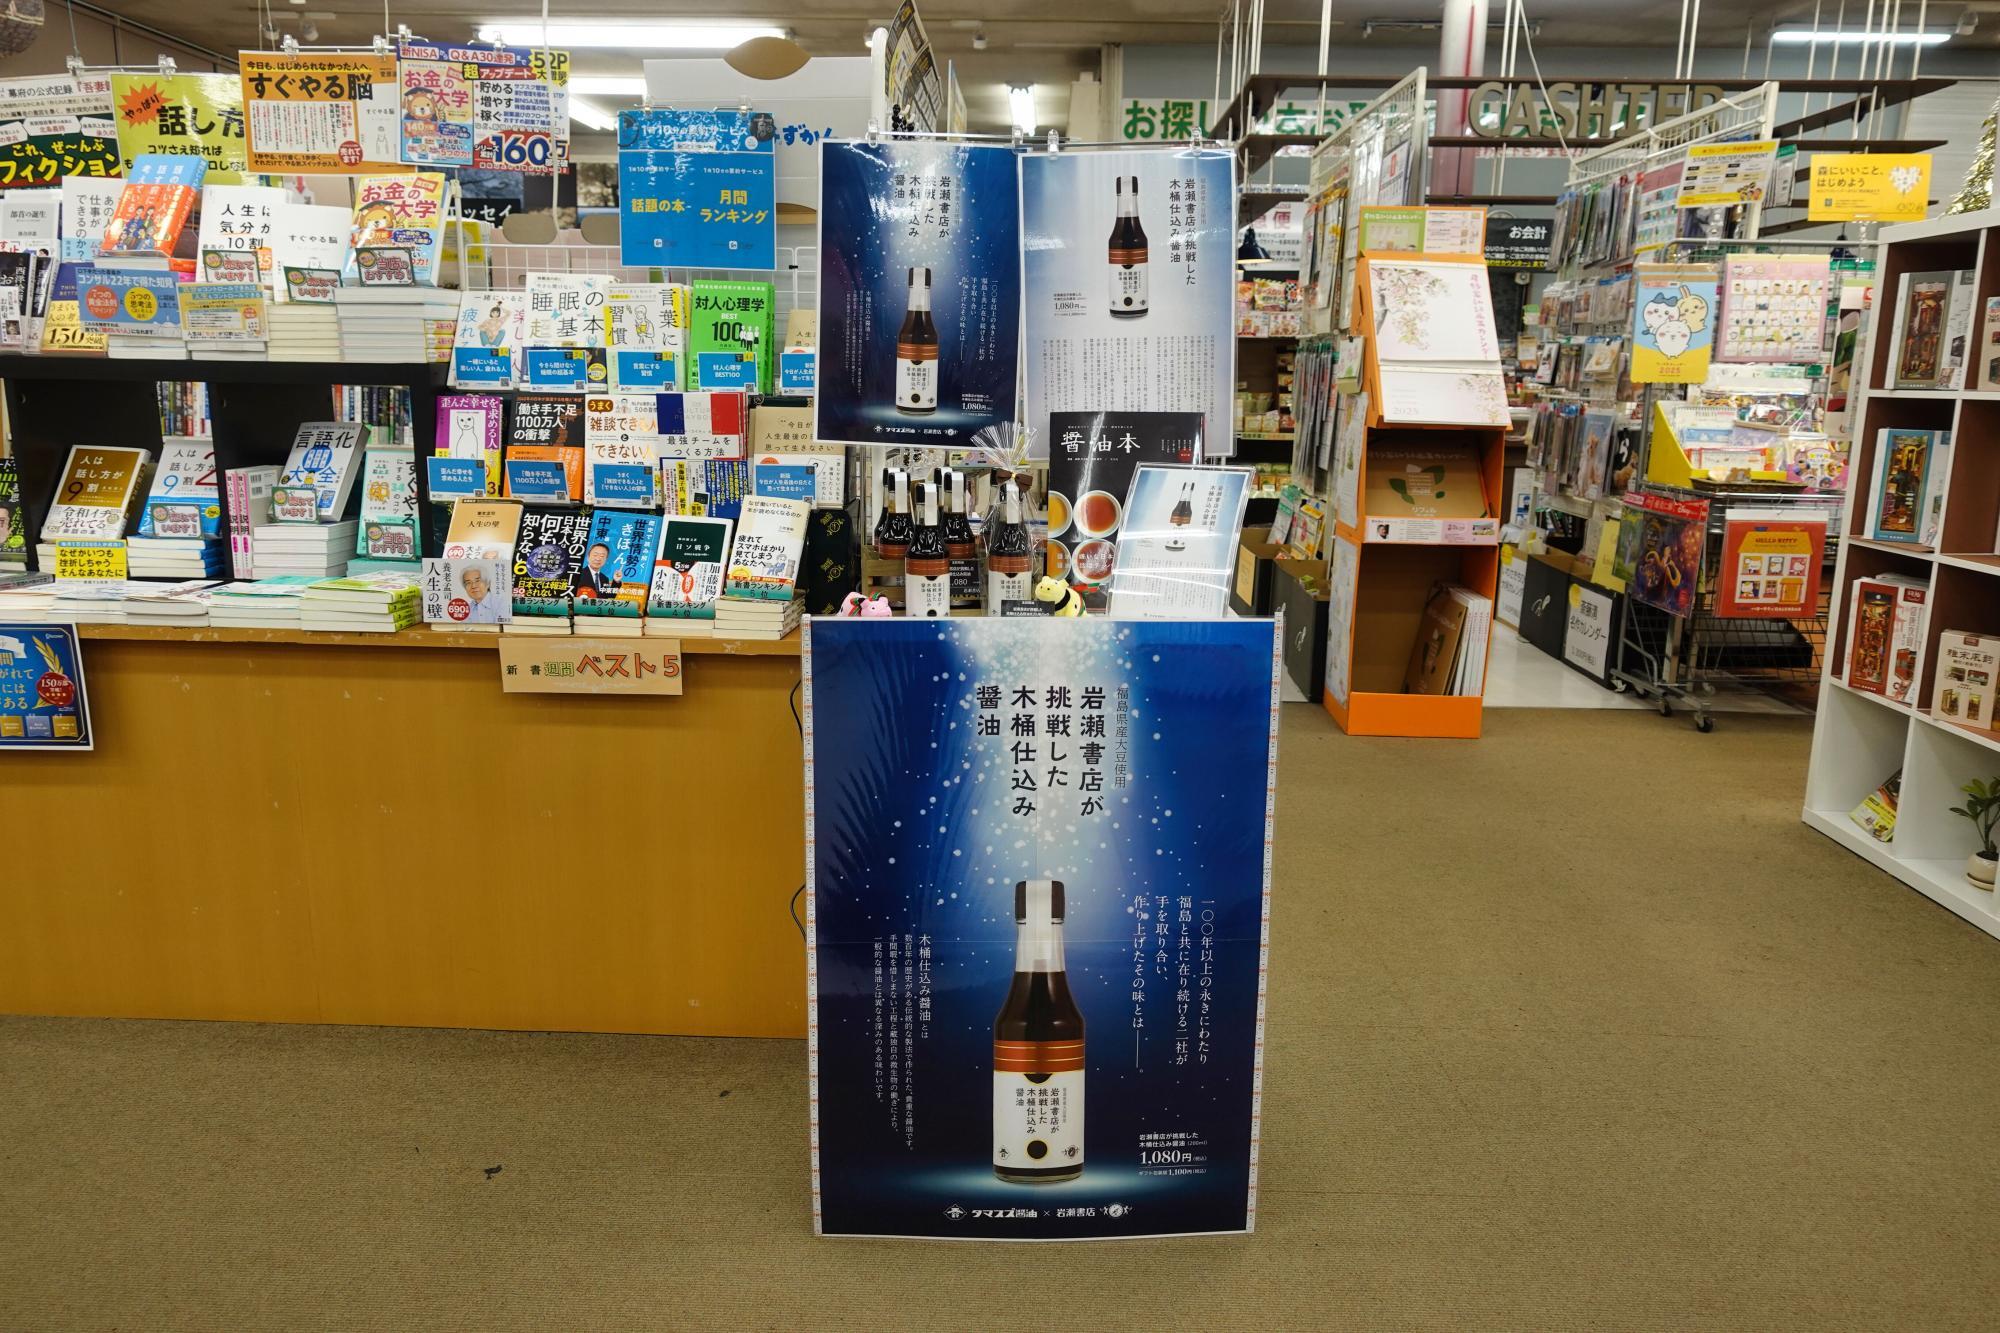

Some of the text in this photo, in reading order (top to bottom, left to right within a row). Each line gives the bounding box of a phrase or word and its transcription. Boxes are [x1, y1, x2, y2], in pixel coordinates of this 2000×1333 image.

[401, 47, 438, 59] 新NISA
[248, 72, 373, 101] すぐやる脳
[405, 70, 454, 88] お金の
[8, 85, 73, 98] 幕府の公式記録
[480, 82, 513, 95] 貯める
[125, 94, 160, 118] やっぱり
[432, 90, 469, 108] 大学
[480, 96, 514, 108] 増やす
[480, 110, 502, 121] 稼ぐ
[147, 143, 222, 157] コツさえ知れば
[1817, 166, 1884, 177] 森にいいこと、
[894, 174, 906, 200] 醤油
[1816, 178, 1865, 188] はじめよう
[361, 183, 421, 202] お金の
[719, 189, 748, 206] 月間
[90, 194, 102, 228] 仕事が
[393, 200, 438, 219] 大学
[631, 198, 685, 213] 話題の本
[938, 175, 951, 239] 岩瀬書店が
[10, 209, 47, 219] 部首の誕生
[699, 208, 769, 225] ランキング
[1169, 178, 1181, 263] 木桶仕込み醤油
[288, 234, 339, 245] すぐやる脳
[1184, 178, 1197, 286] 岩瀬書店が挑戦した
[1509, 225, 1548, 240] お会計
[227, 237, 265, 250] 10割
[474, 294, 523, 302] 一緒にいると
[531, 291, 604, 313] 睡眠の
[695, 296, 765, 311] 対人心理学
[1055, 301, 1080, 311] 1,080円
[658, 288, 679, 347] 言葉に
[529, 314, 605, 339] 超基本
[608, 305, 628, 346] 習慣
[711, 321, 743, 342] 100
[49, 328, 84, 345] 150
[441, 398, 499, 409] 歪んだ幸せを
[515, 403, 577, 416] 「働き手不足
[589, 401, 611, 411] うまく
[515, 416, 568, 429] 1100万人」
[295, 431, 355, 450] 言語化
[513, 429, 551, 441] の衝撃
[667, 436, 731, 446] 最強チームを
[1060, 431, 1141, 454] 醤油本
[173, 449, 197, 458] 人は
[673, 447, 725, 457] つくる方法
[765, 444, 835, 452] 思って生きなさい
[80, 456, 104, 466] 人は
[75, 468, 124, 480] 話し方が
[67, 480, 99, 502] 9割
[748, 500, 793, 510] なぜ働いていると
[747, 508, 802, 518] 本が読めなくなるのか
[60, 518, 108, 530] 売れてる
[466, 519, 500, 529] 人生の壁
[538, 514, 563, 545] 何も
[515, 513, 540, 562] 知らない
[559, 516, 574, 549] 日本人は
[738, 535, 764, 543] 疲れて
[612, 523, 634, 565] きほん
[623, 519, 648, 578] 世界情勢の
[675, 543, 711, 551] 日ソ戦争
[736, 542, 785, 554] スマホばかり
[59, 549, 115, 558] なぜかいつも
[734, 551, 773, 560] 見てしまう
[59, 559, 112, 568] 挫折しちゃう
[513, 560, 527, 575] 6
[733, 559, 767, 568] あなたへ
[59, 568, 124, 578] そんなあなたに
[443, 562, 453, 600] 養老孟司
[518, 580, 569, 592] 日本では報道
[734, 581, 784, 591] 新書ランキング
[427, 561, 443, 619] 人生の壁
[525, 588, 557, 598] されない
[750, 590, 769, 598] 5位
[512, 597, 560, 607] 新書ランキング
[582, 598, 630, 608] 新書ランキング
[656, 600, 707, 609] 新書ランキング
[596, 607, 615, 615] 3位
[672, 609, 691, 617] 4位
[576, 653, 681, 678] ベスト5
[976, 685, 1003, 736] 醤油
[1045, 685, 1073, 787] 挑戦した
[1114, 687, 1129, 788] 福島県産大豆使用
[1010, 685, 1037, 817] 木桶仕込み
[1078, 686, 1106, 816] 岩瀬書店が
[1154, 895, 1169, 981] 手を取り合い、
[918, 933, 931, 1039] 木桶仕込み醤油とは
[1175, 895, 1192, 1065] 福島と共に在り続ける二社が
[1198, 899, 1215, 1064] 一〇〇年以上の永きにわたり
[874, 936, 884, 1103] 一般的な醤油とは異なる深みのある味わいです。
[1016, 1087, 1025, 1107] 醤油
[1026, 1087, 1037, 1134] 木桶仕込み
[1038, 1087, 1048, 1125] 挑戦した
[1050, 1087, 1060, 1134] 岩瀬書店が
[1139, 1132, 1199, 1140] 岩瀬書店が挑戦した
[1139, 1140, 1186, 1148] 木桶仕込み醤油
[1139, 1150, 1192, 1166] 1,080円
[972, 1207, 1096, 1219] タマスズ醤油 岩瀬書店
